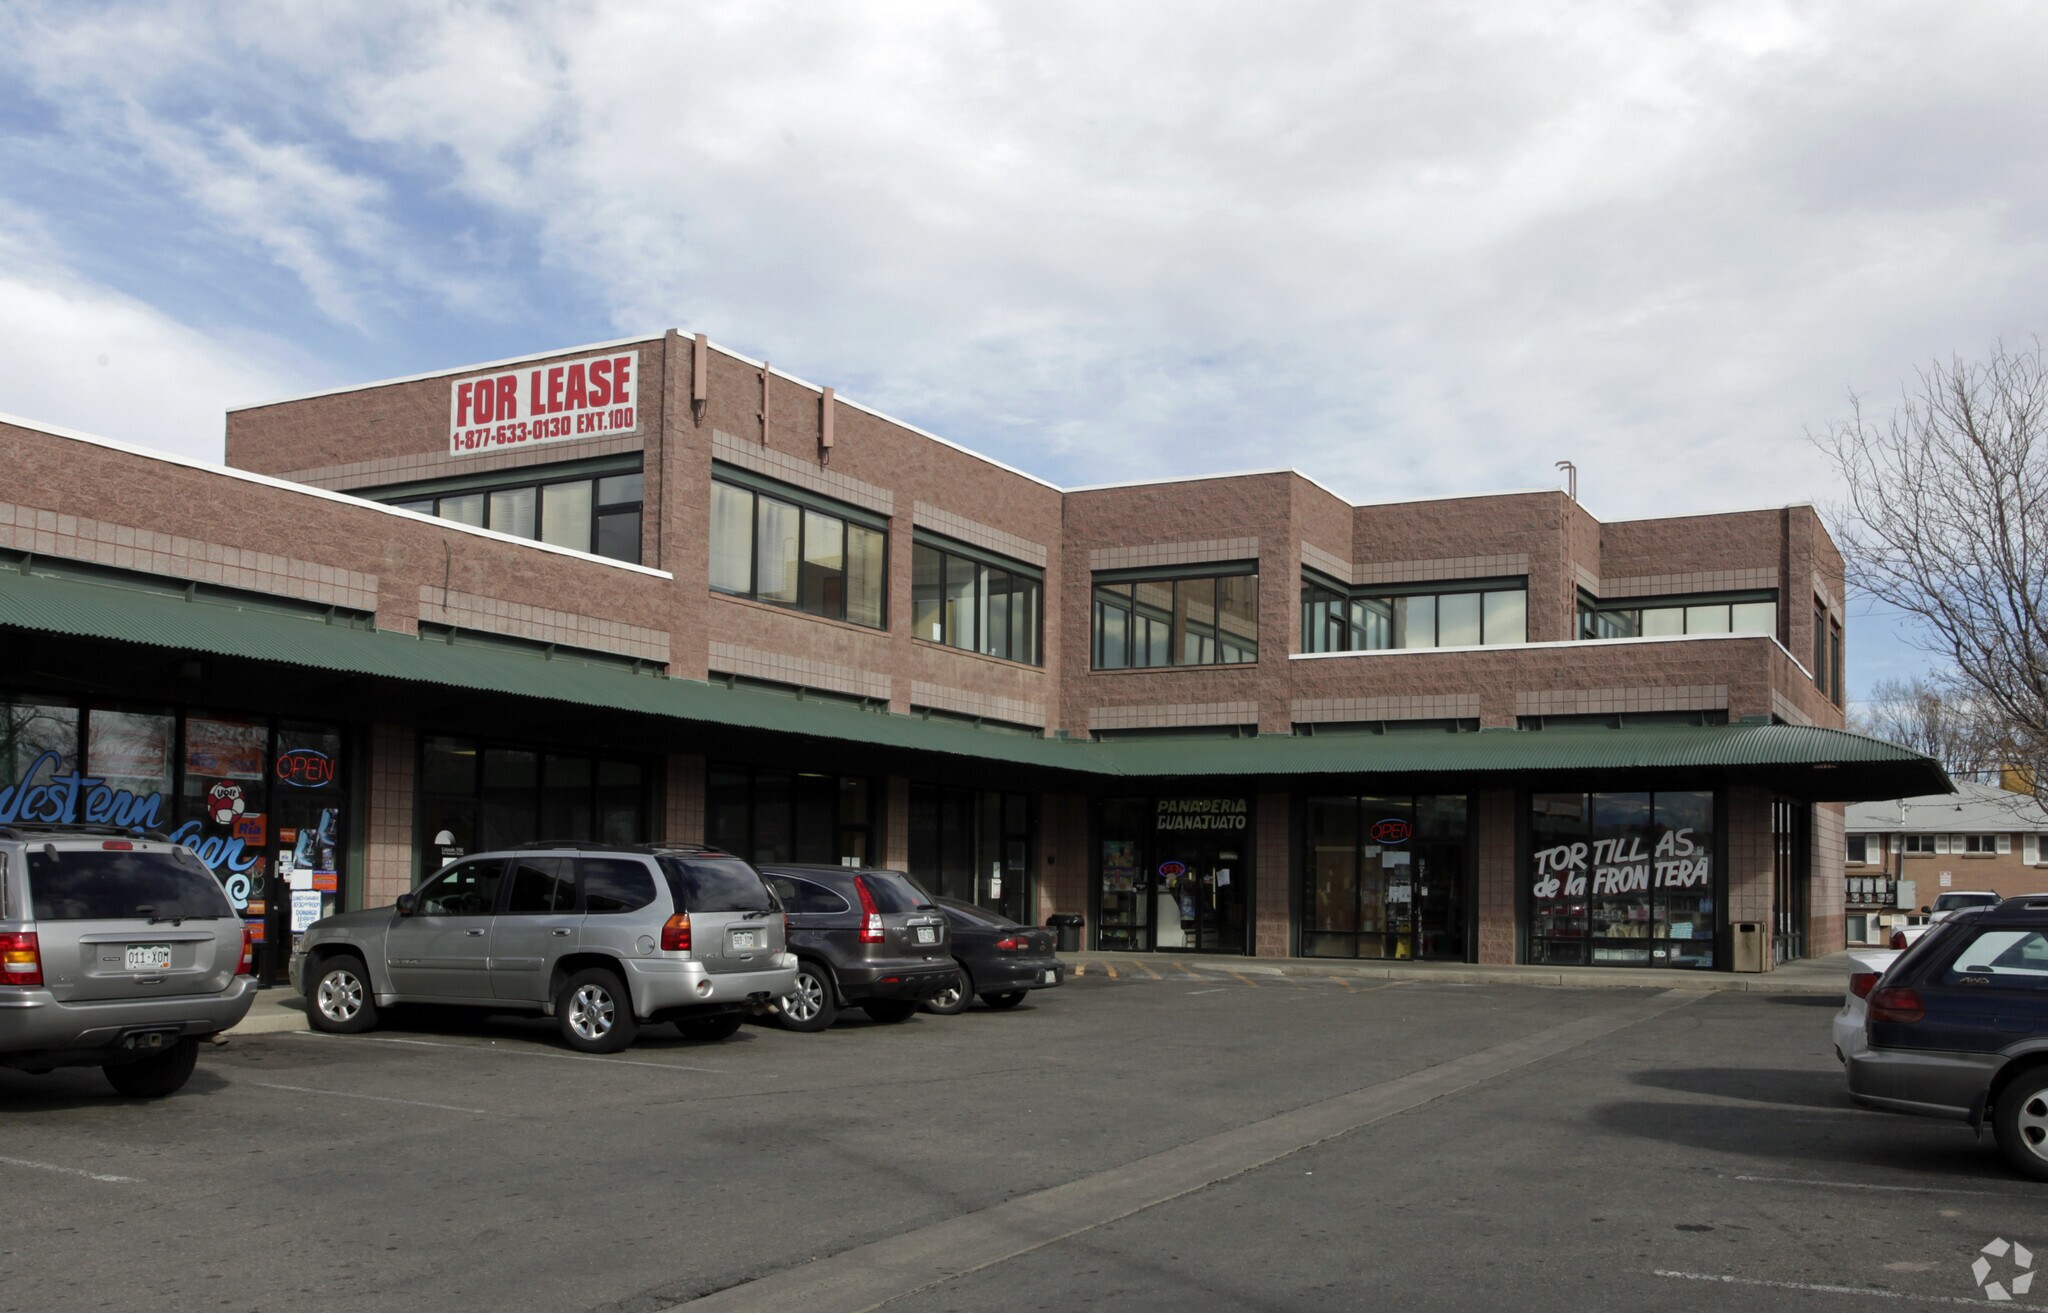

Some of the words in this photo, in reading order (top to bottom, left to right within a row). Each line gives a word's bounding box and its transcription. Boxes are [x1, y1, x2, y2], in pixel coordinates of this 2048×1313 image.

[457, 374, 518, 427] FOR
[530, 356, 631, 416] LEASE
[453, 415, 571, 450] 1-877-633-0130
[276, 755, 335, 781] OPEN
[1157, 799, 1247, 813] PANADERIA
[1157, 815, 1246, 829] GUANAJUATO
[1370, 823, 1413, 839] OPEN
[1533, 874, 1561, 898] de
[1563, 871, 1587, 896] la
